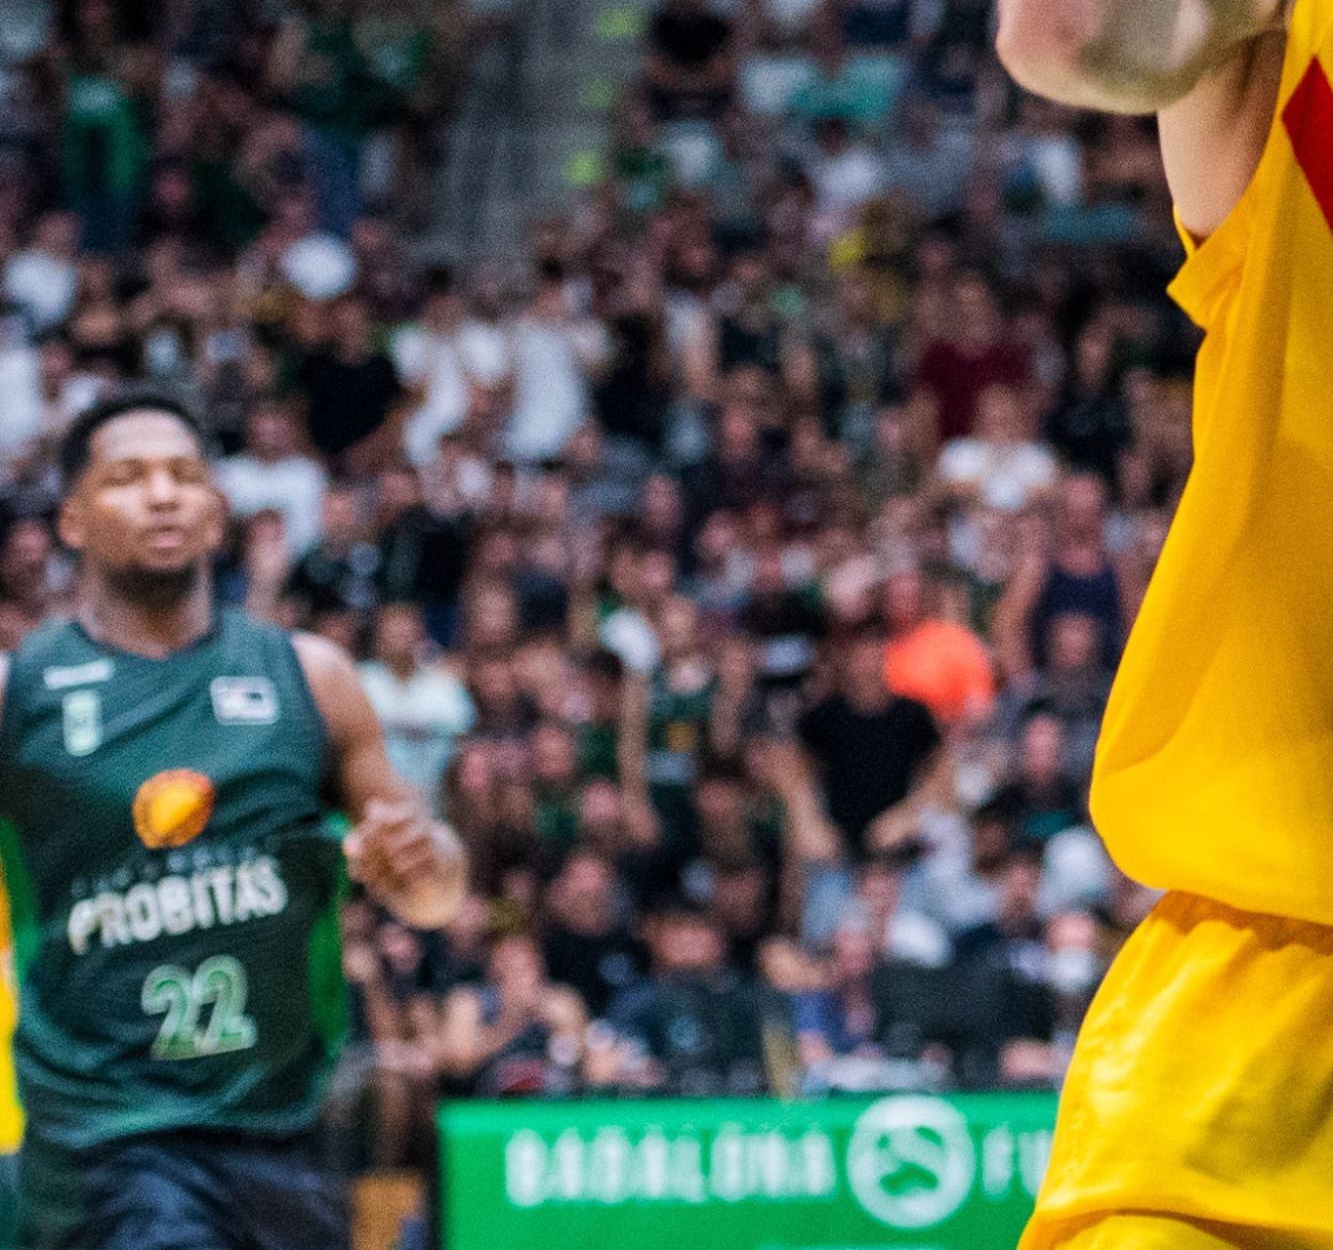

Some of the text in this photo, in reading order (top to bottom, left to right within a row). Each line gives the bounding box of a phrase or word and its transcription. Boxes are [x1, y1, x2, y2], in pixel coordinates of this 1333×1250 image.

[67, 855, 288, 955] PROBITAS
[142, 954, 258, 1060] 22
[505, 1125, 836, 1208] BADALONA
